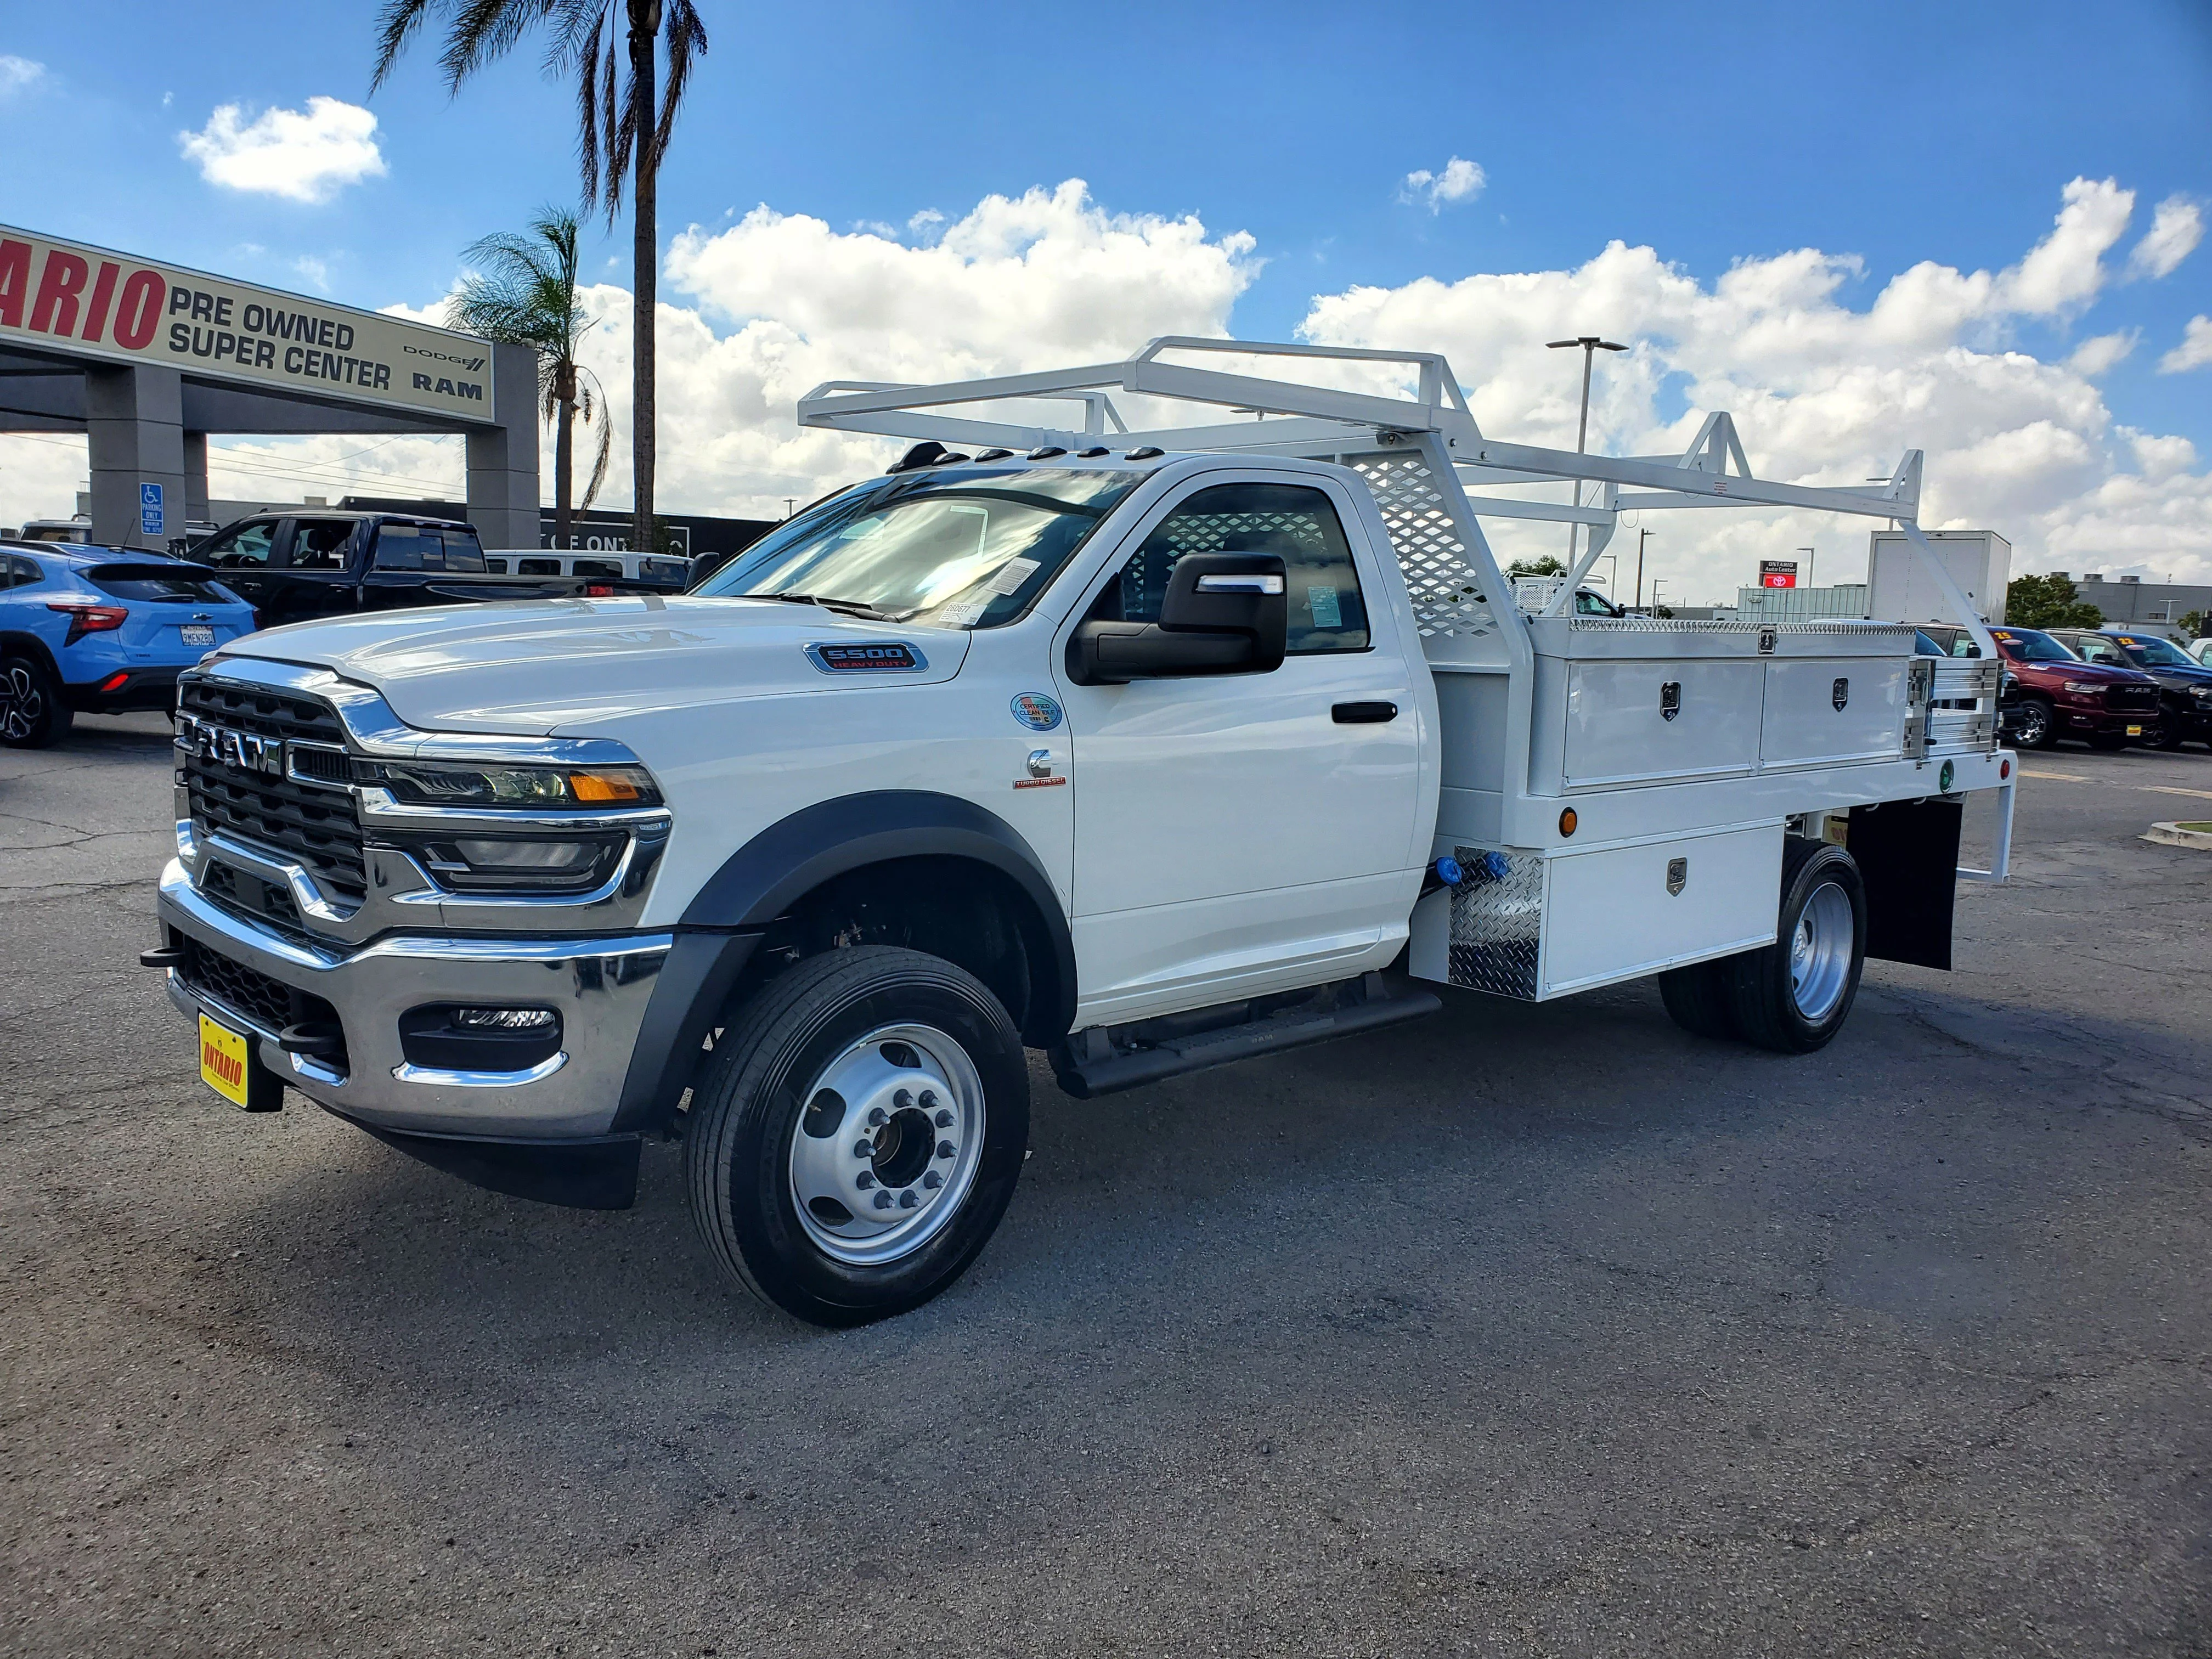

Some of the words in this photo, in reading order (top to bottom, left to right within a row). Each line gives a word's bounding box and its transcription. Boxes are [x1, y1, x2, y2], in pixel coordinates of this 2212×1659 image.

[169, 286, 234, 326] PRE
[243, 304, 354, 351] OWNED
[169, 323, 275, 369] SUPER
[284, 347, 391, 390] CENTER
[403, 346, 473, 365] DODGE
[413, 372, 482, 400] RAM
[142, 503, 161, 512] PARKING
[827, 649, 904, 659] 5500
[1030, 749, 1048, 767] Cummins
[204, 1041, 242, 1086] ONTARIO
